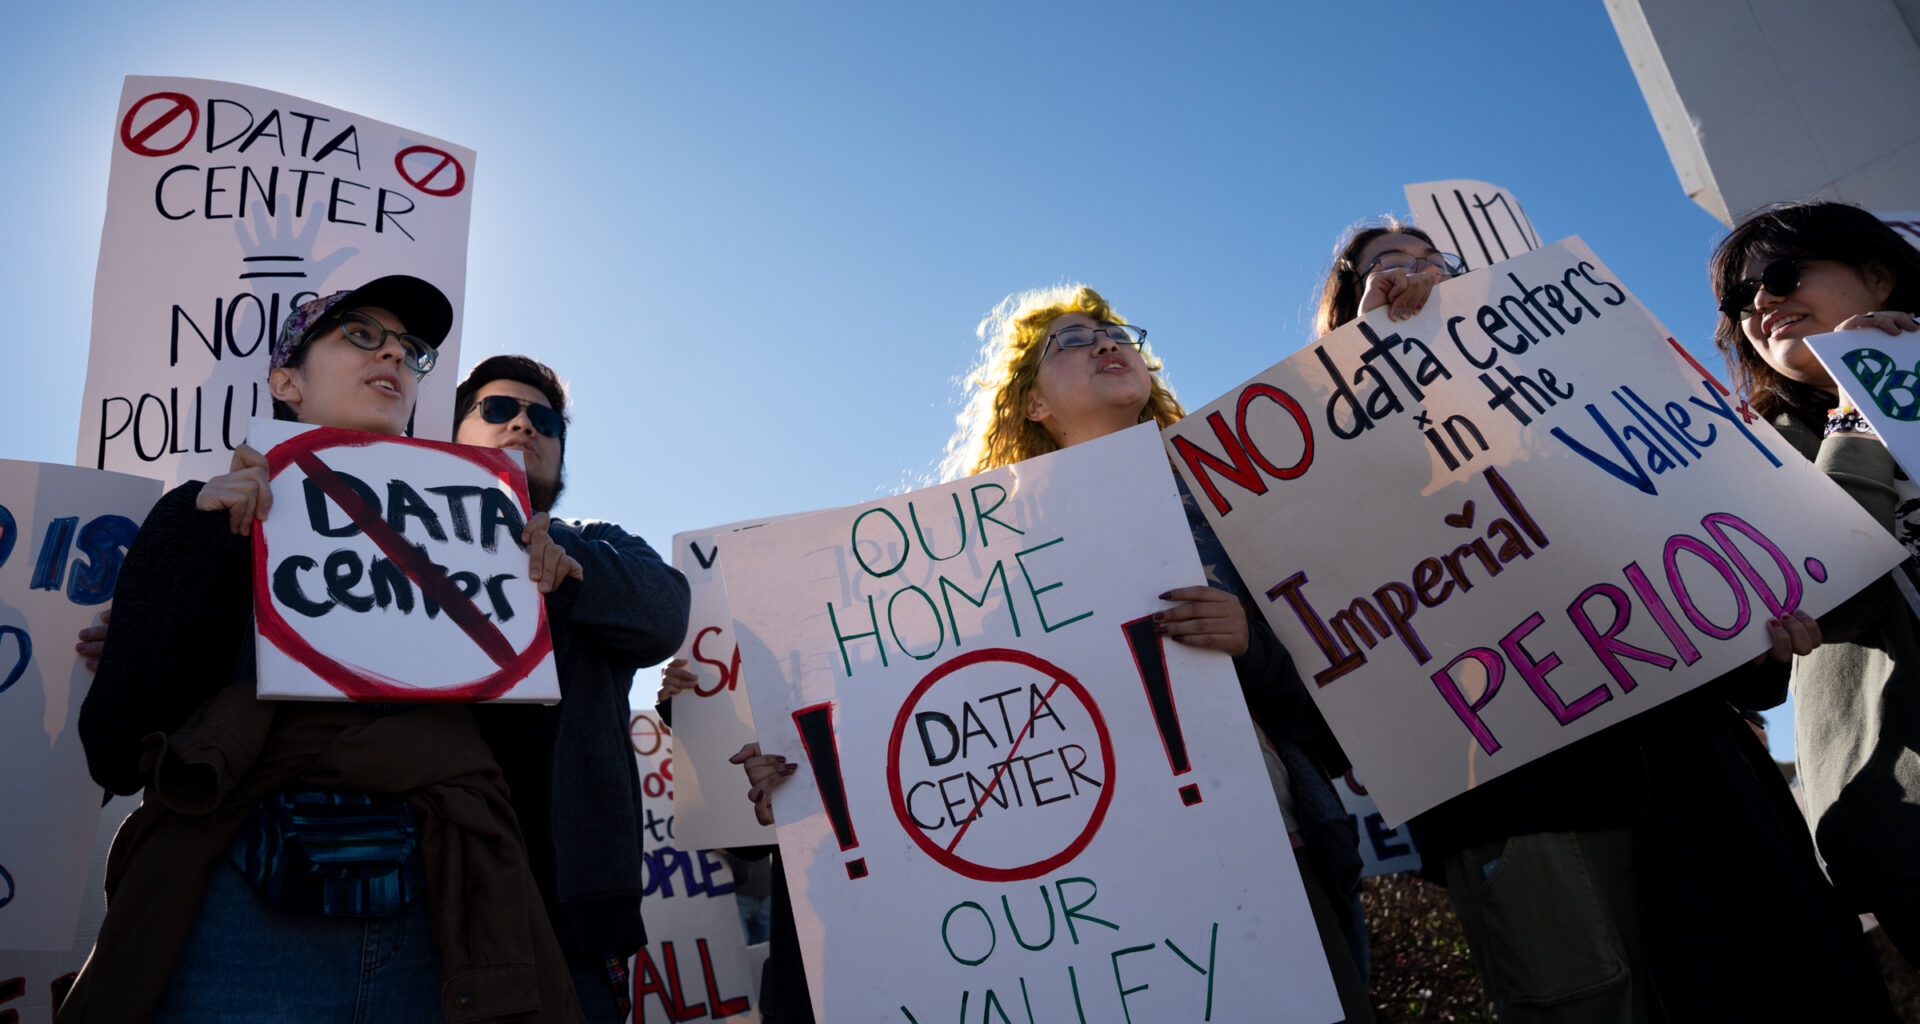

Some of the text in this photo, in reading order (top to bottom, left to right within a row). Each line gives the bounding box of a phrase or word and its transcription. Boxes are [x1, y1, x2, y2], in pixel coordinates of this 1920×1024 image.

[206, 98, 361, 170] DATA
[155, 164, 415, 241] CENTER
[170, 290, 355, 366] NOI
[1169, 260, 1627, 517] NO data centers
[1412, 363, 1575, 472] in the
[302, 470, 530, 554] DATA
[851, 483, 1025, 578] OUR
[827, 537, 1094, 677] HOME
[1266, 466, 1549, 688] Imperial
[1431, 512, 1828, 756] PERIOD.
[915, 683, 1066, 767] DATA
[906, 744, 1102, 831] CENTER
[942, 877, 1120, 967] OUR
